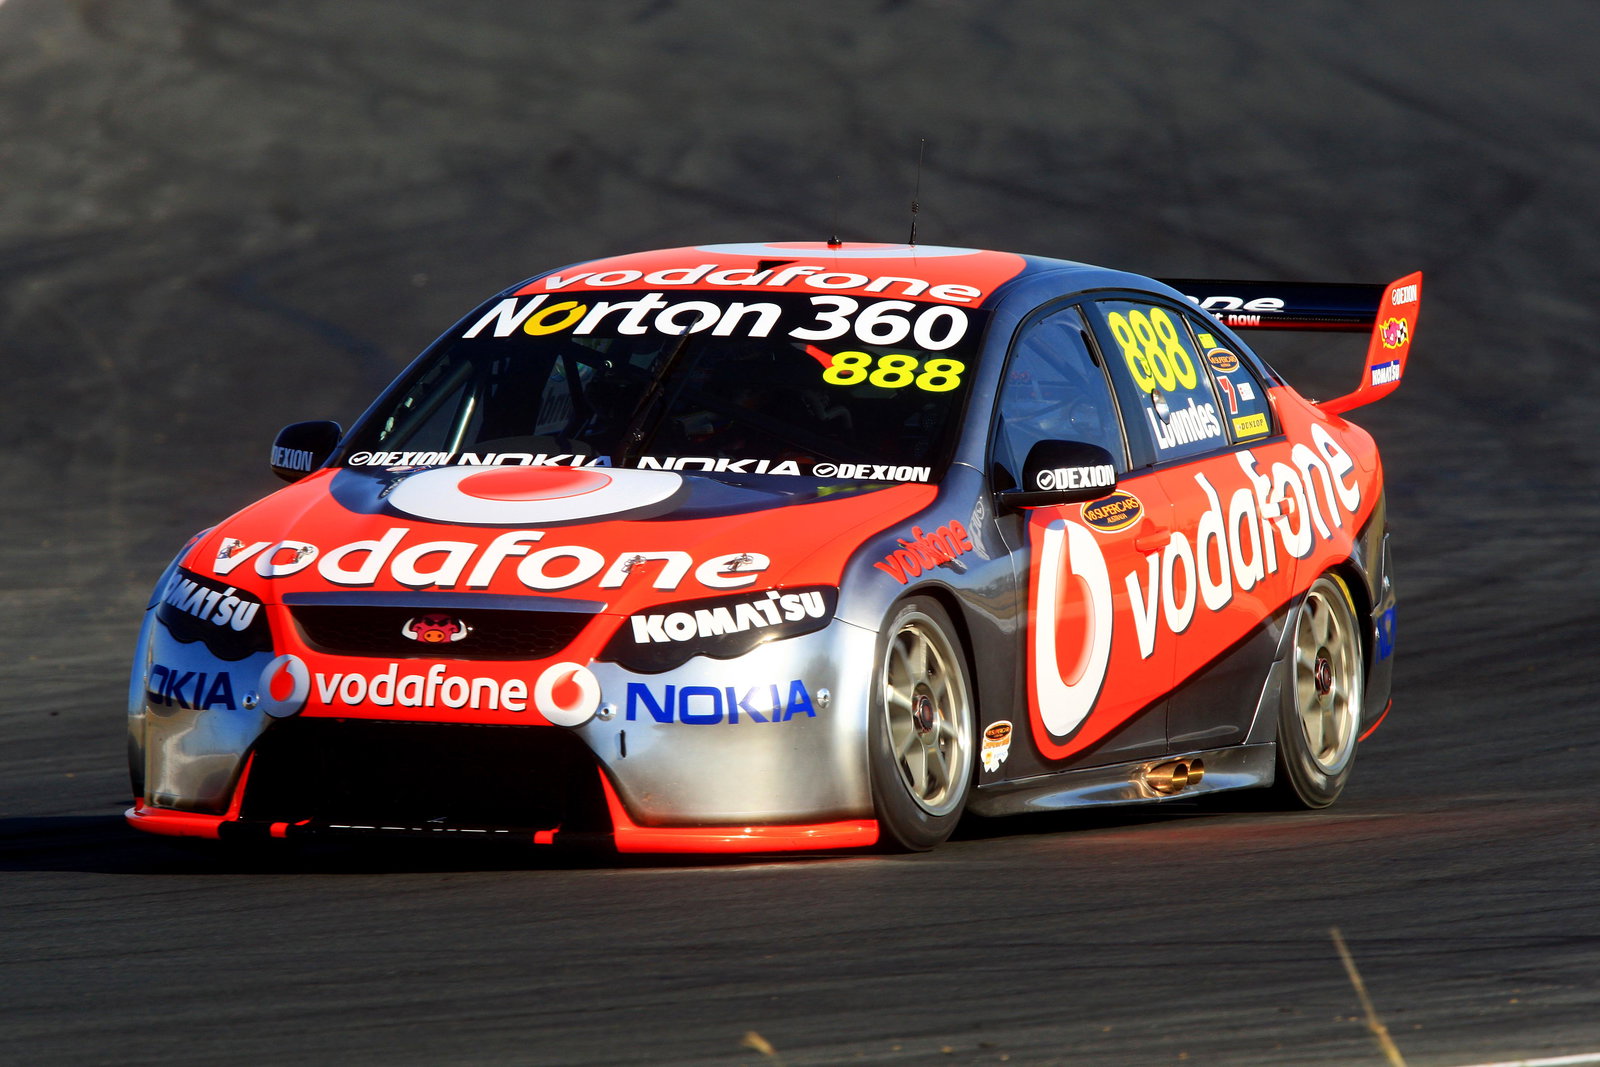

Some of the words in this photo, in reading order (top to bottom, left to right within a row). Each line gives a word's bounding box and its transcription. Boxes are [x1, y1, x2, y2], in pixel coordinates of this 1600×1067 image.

[543, 264, 982, 302] vodafone
[463, 293, 782, 338] Norton
[788, 296, 969, 350] 360
[1229, 315, 1260, 326] now
[1108, 308, 1197, 393] 888
[823, 351, 965, 392] 888
[1216, 375, 1238, 414] 7
[1147, 397, 1221, 450] Lowndes
[1241, 419, 1265, 429] DUNLOP
[271, 446, 313, 472] DEXION
[366, 452, 451, 466] DEXION
[458, 453, 612, 467] NOKIA
[637, 456, 800, 476] NOKIA
[837, 464, 931, 482] DEXION
[1055, 465, 1116, 489] DEXION
[213, 527, 770, 591] vodafone
[1125, 423, 1361, 660] vodafone
[631, 591, 826, 643] KOMATSU
[315, 663, 528, 712] vodafone
[626, 679, 816, 725] NOKIA
